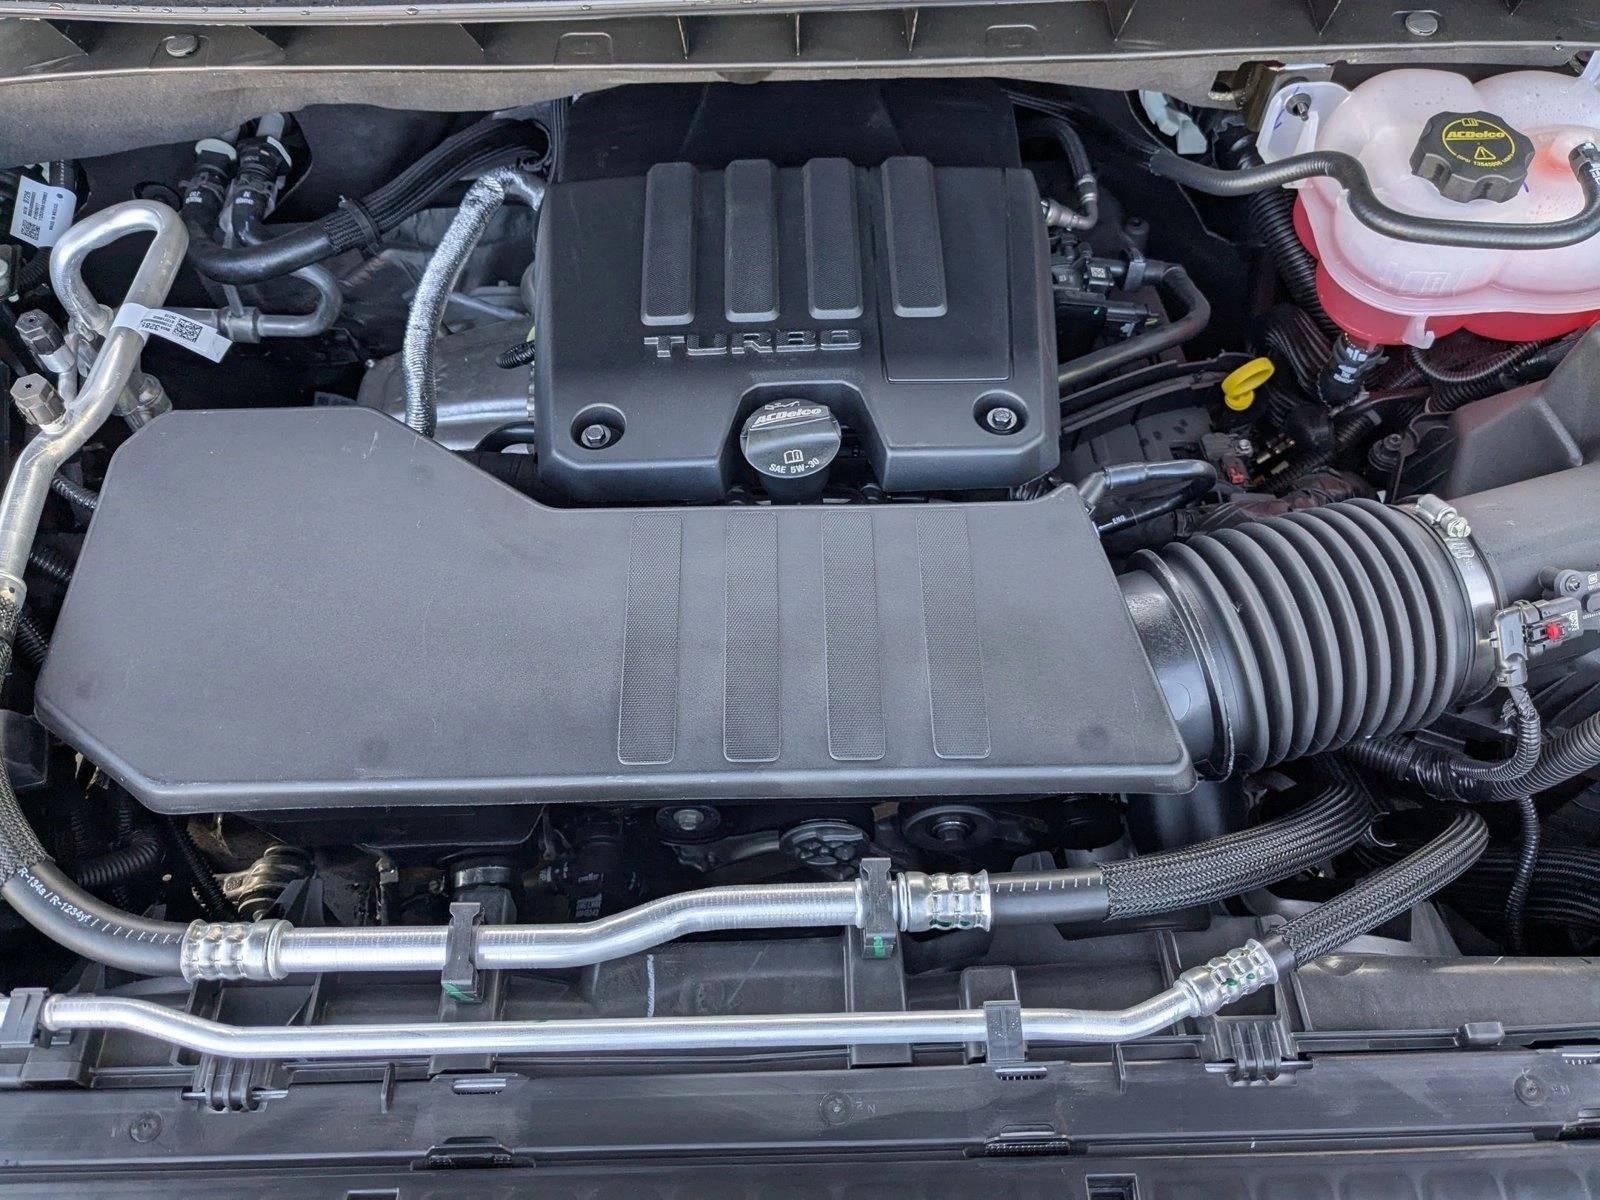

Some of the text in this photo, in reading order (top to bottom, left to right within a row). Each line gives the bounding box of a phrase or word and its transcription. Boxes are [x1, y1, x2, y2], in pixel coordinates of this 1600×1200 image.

[1445, 131, 1506, 139] ACDelco
[643, 329, 862, 357] TURBO
[753, 408, 822, 426] ACDelco
[769, 457, 820, 474] SAE 5W-30
[17, 866, 47, 896] R-134a
